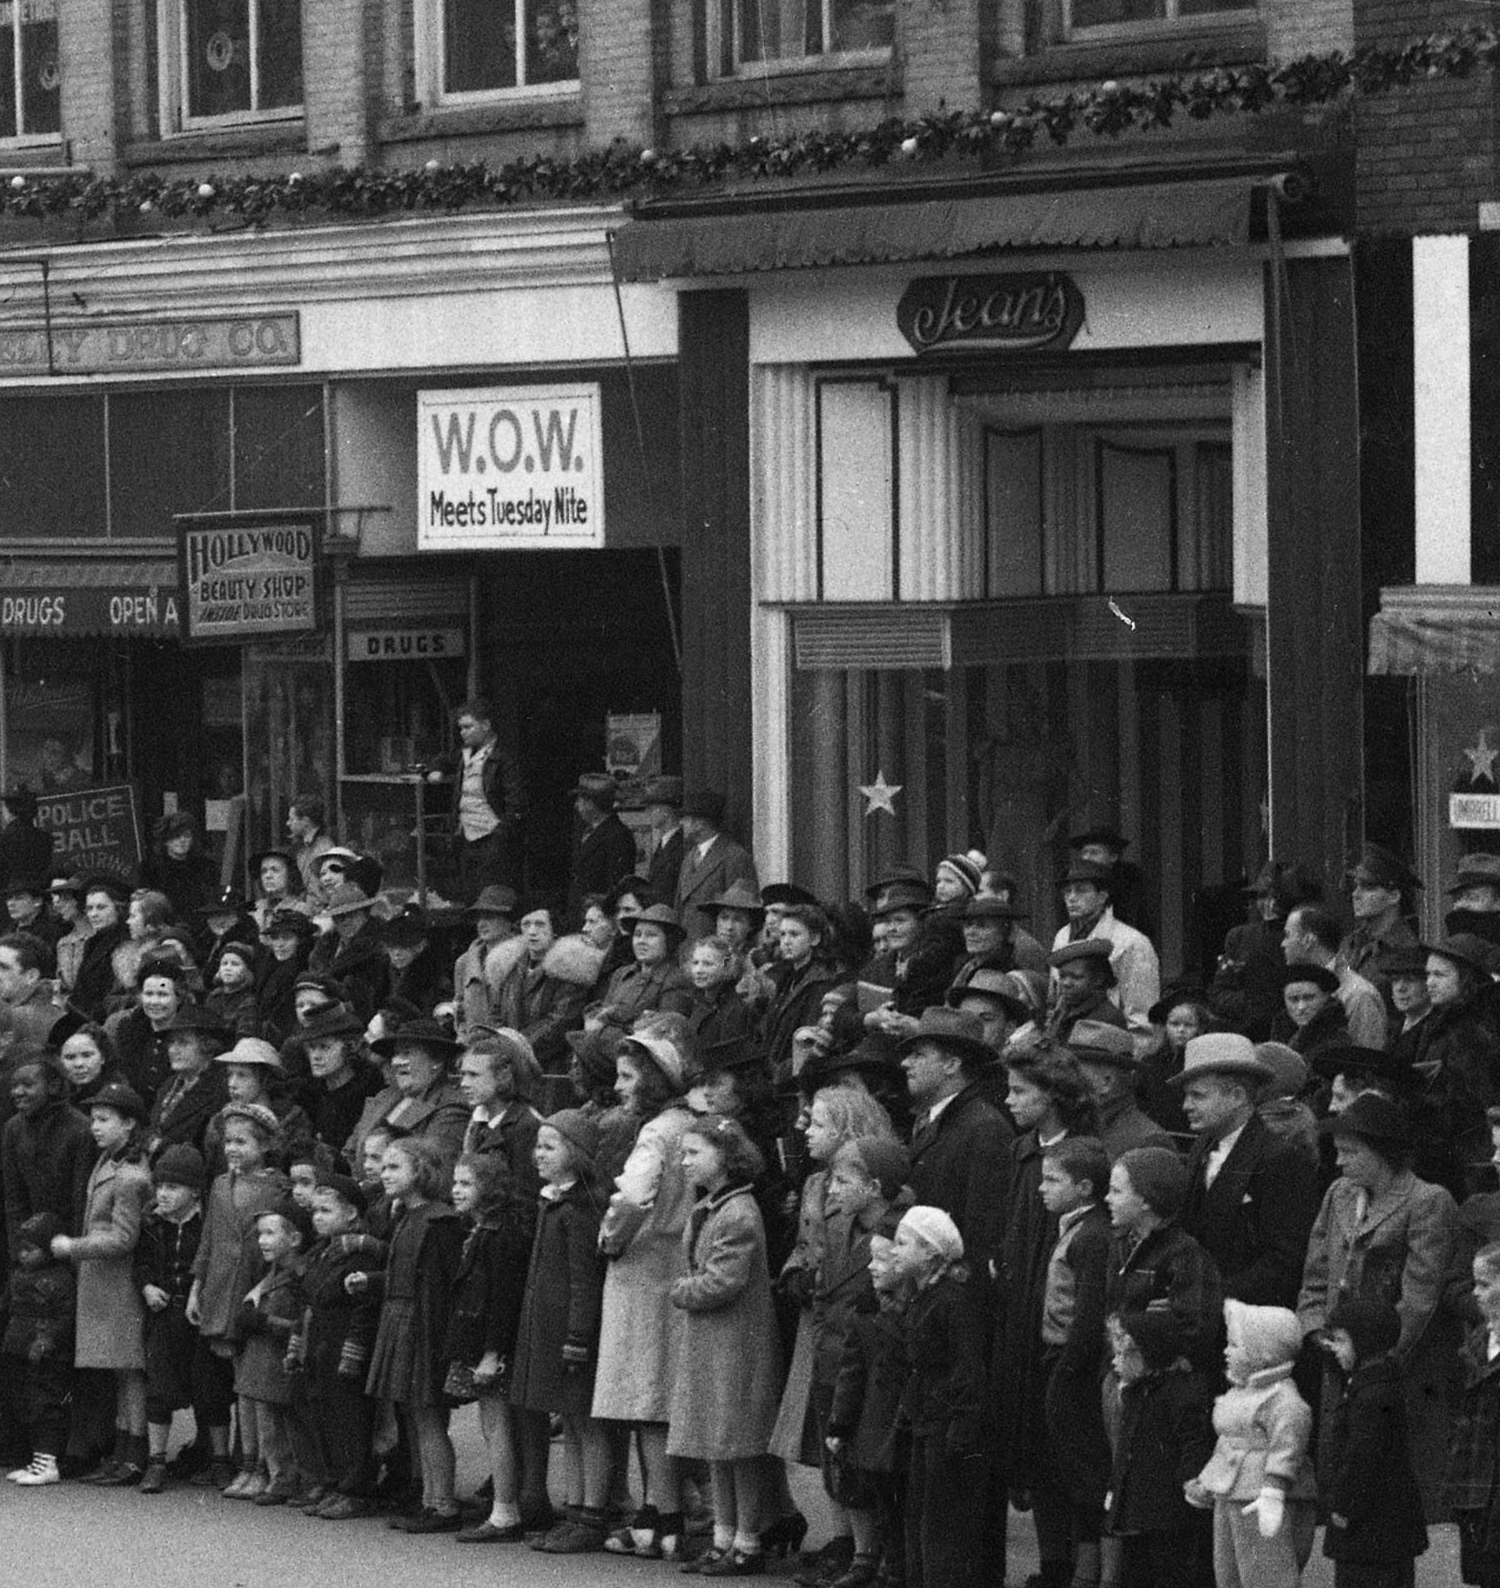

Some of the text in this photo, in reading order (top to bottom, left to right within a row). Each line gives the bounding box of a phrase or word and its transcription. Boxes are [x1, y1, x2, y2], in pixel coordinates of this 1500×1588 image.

[912, 274, 1068, 349] Jean's
[107, 324, 208, 363] DRUG
[431, 408, 586, 476] W.O.W.
[430, 487, 588, 535] Meets Tuesday Nite
[189, 530, 312, 585] HOLLYWOOD
[200, 576, 307, 602] BEAUTY SHOP
[1, 594, 66, 624] DRUGS
[109, 595, 158, 625] OPEN
[163, 597, 180, 624] A
[368, 634, 446, 655] DRUGS
[37, 795, 125, 828] POLICE
